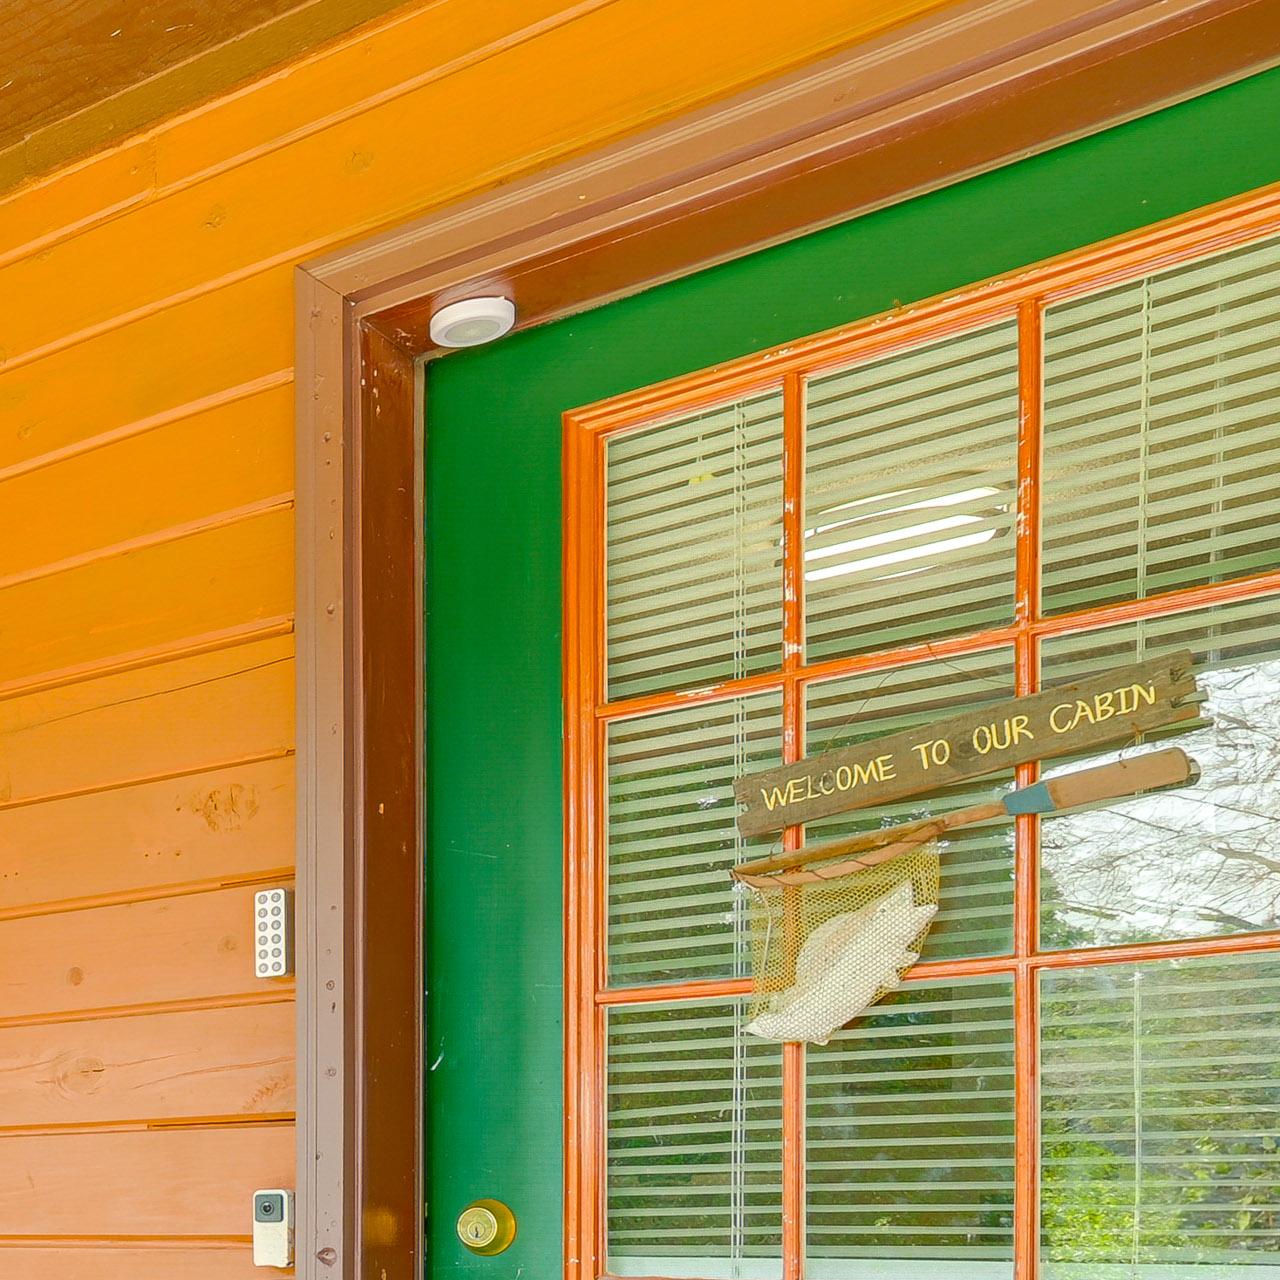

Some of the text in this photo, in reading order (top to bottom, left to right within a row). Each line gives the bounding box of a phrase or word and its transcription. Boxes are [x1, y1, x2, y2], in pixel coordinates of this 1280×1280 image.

[761, 684, 1157, 811] WELCOME TO OUR CABIN
